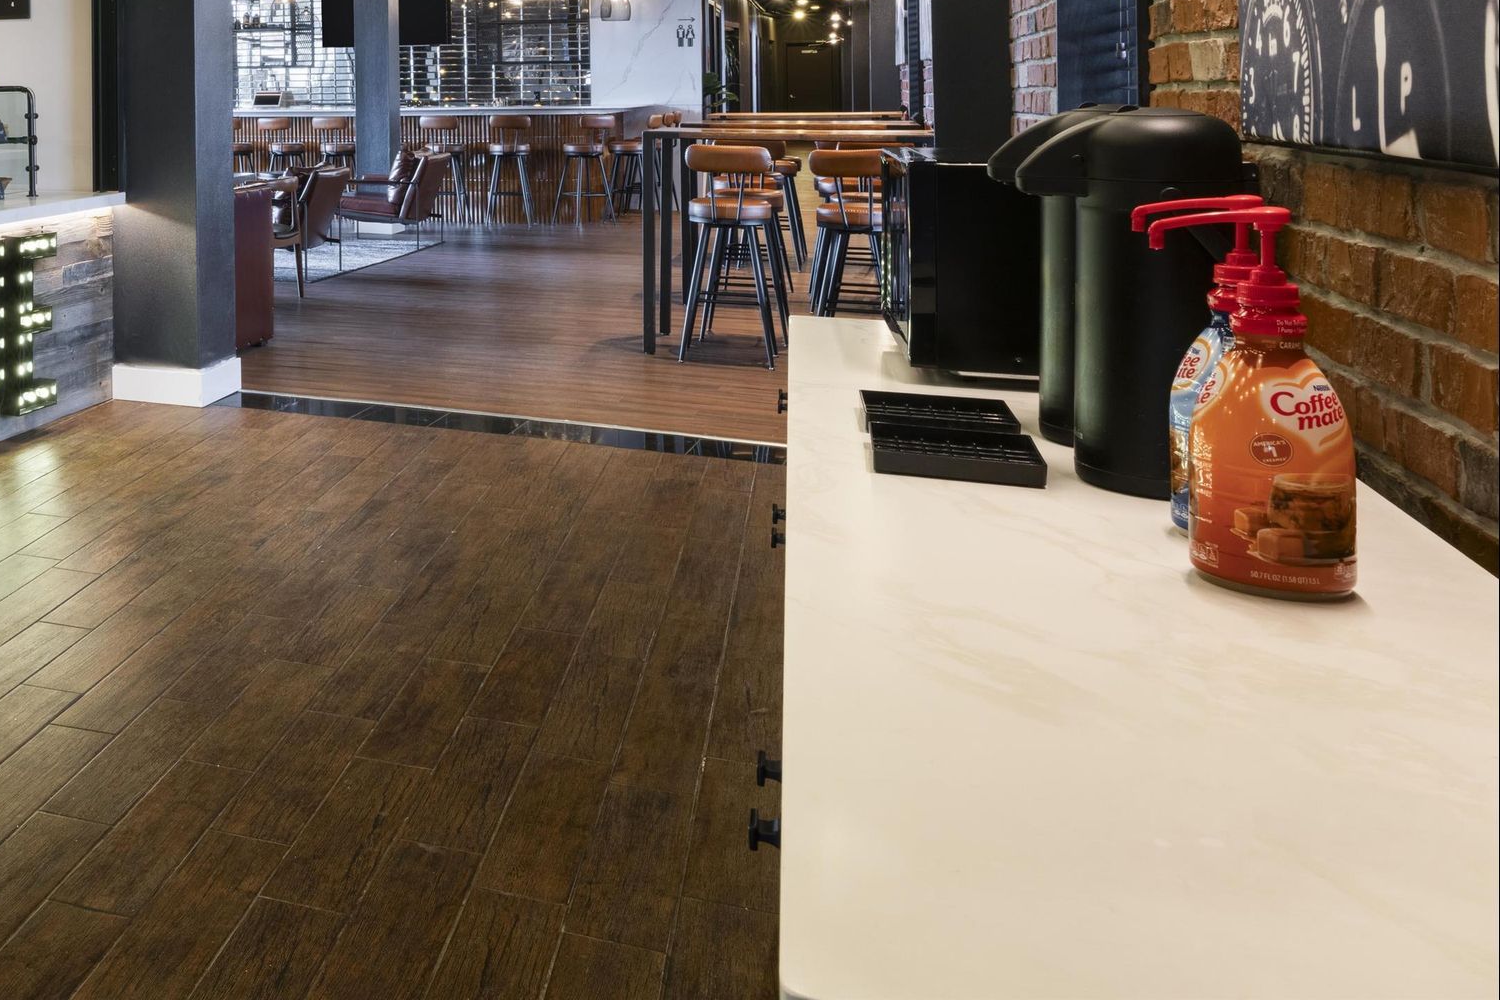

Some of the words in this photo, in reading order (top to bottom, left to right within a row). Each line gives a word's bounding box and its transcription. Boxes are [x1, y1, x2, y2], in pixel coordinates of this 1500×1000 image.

[1255, 18, 1262, 56] 4
[1283, 5, 1290, 48] 6
[1249, 67, 1256, 105] 3
[1292, 51, 1300, 94] 7
[1401, 61, 1412, 116] P
[1352, 85, 1361, 132] L
[1270, 392, 1339, 416] Coffee
[1298, 406, 1344, 431] mate
